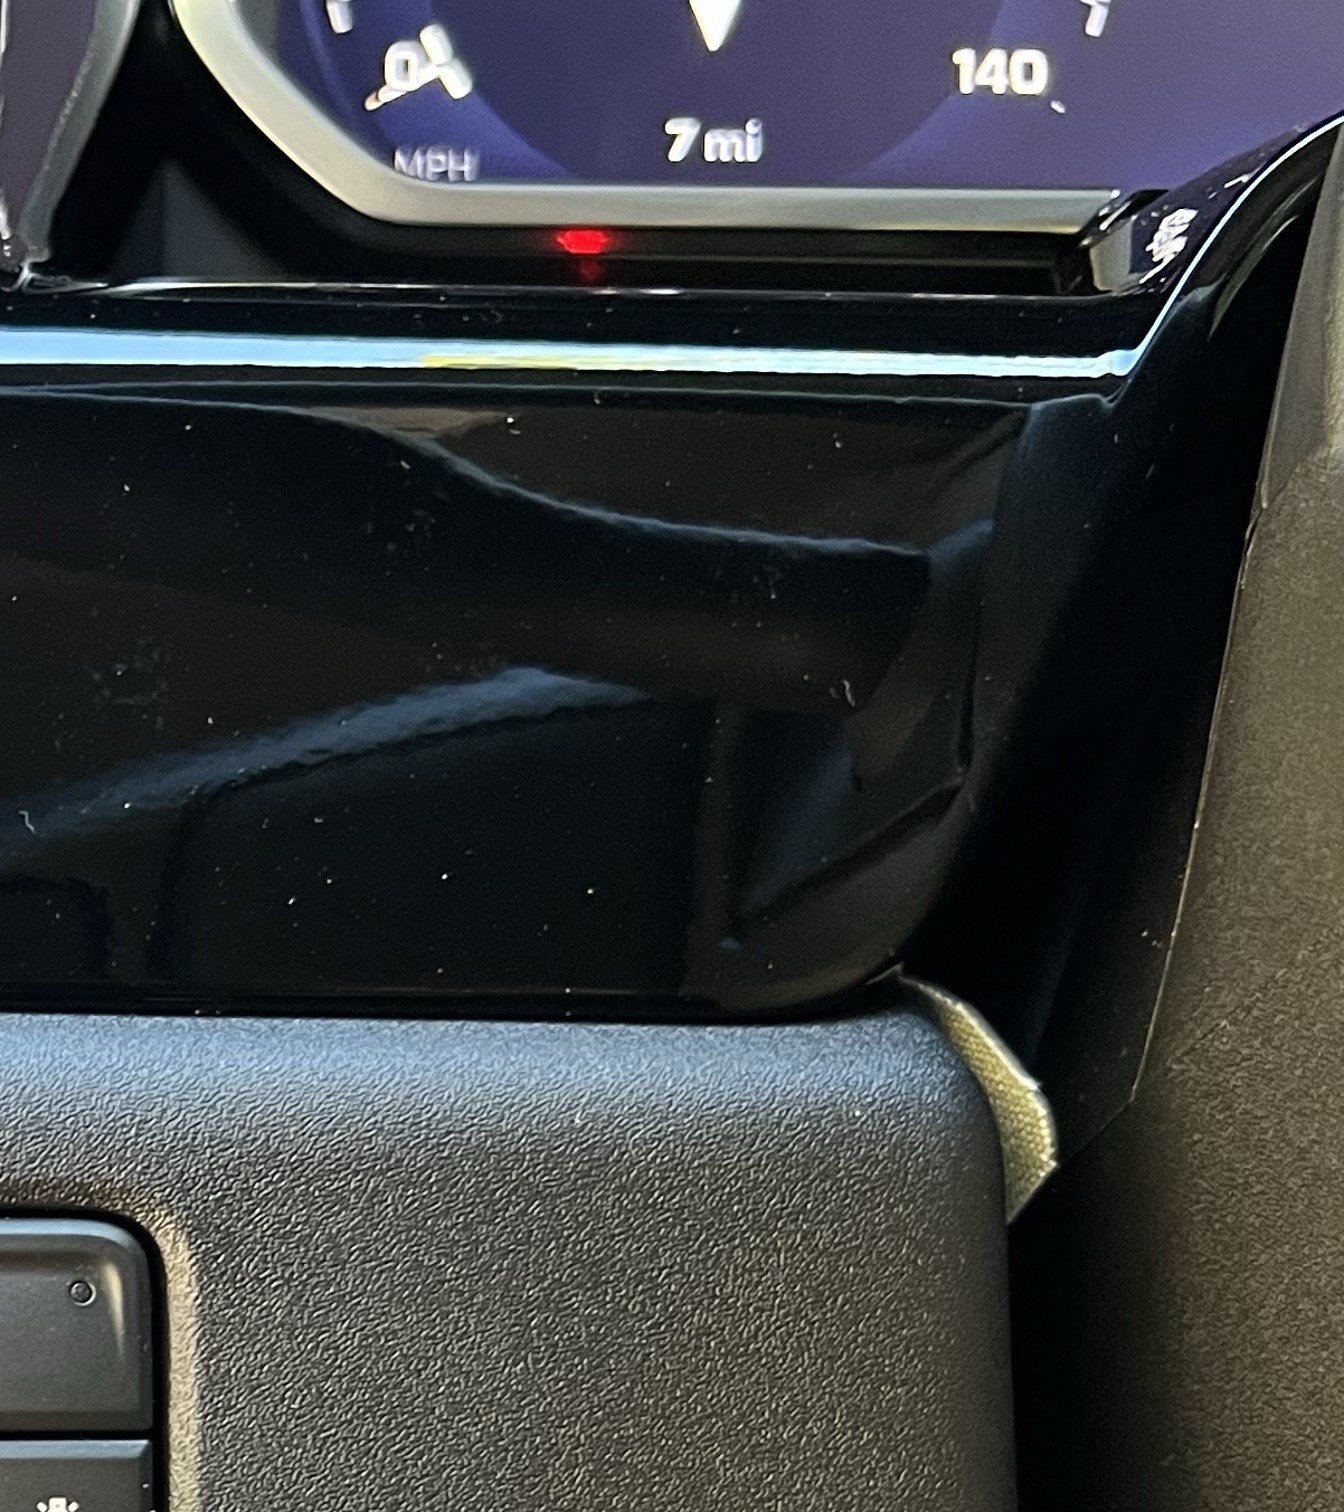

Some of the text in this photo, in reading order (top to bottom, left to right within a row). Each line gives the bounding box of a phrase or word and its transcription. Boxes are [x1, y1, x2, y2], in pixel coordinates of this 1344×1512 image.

[952, 48, 1048, 95] 140
[664, 117, 765, 162] 7 mi
[393, 145, 479, 182] MPH
